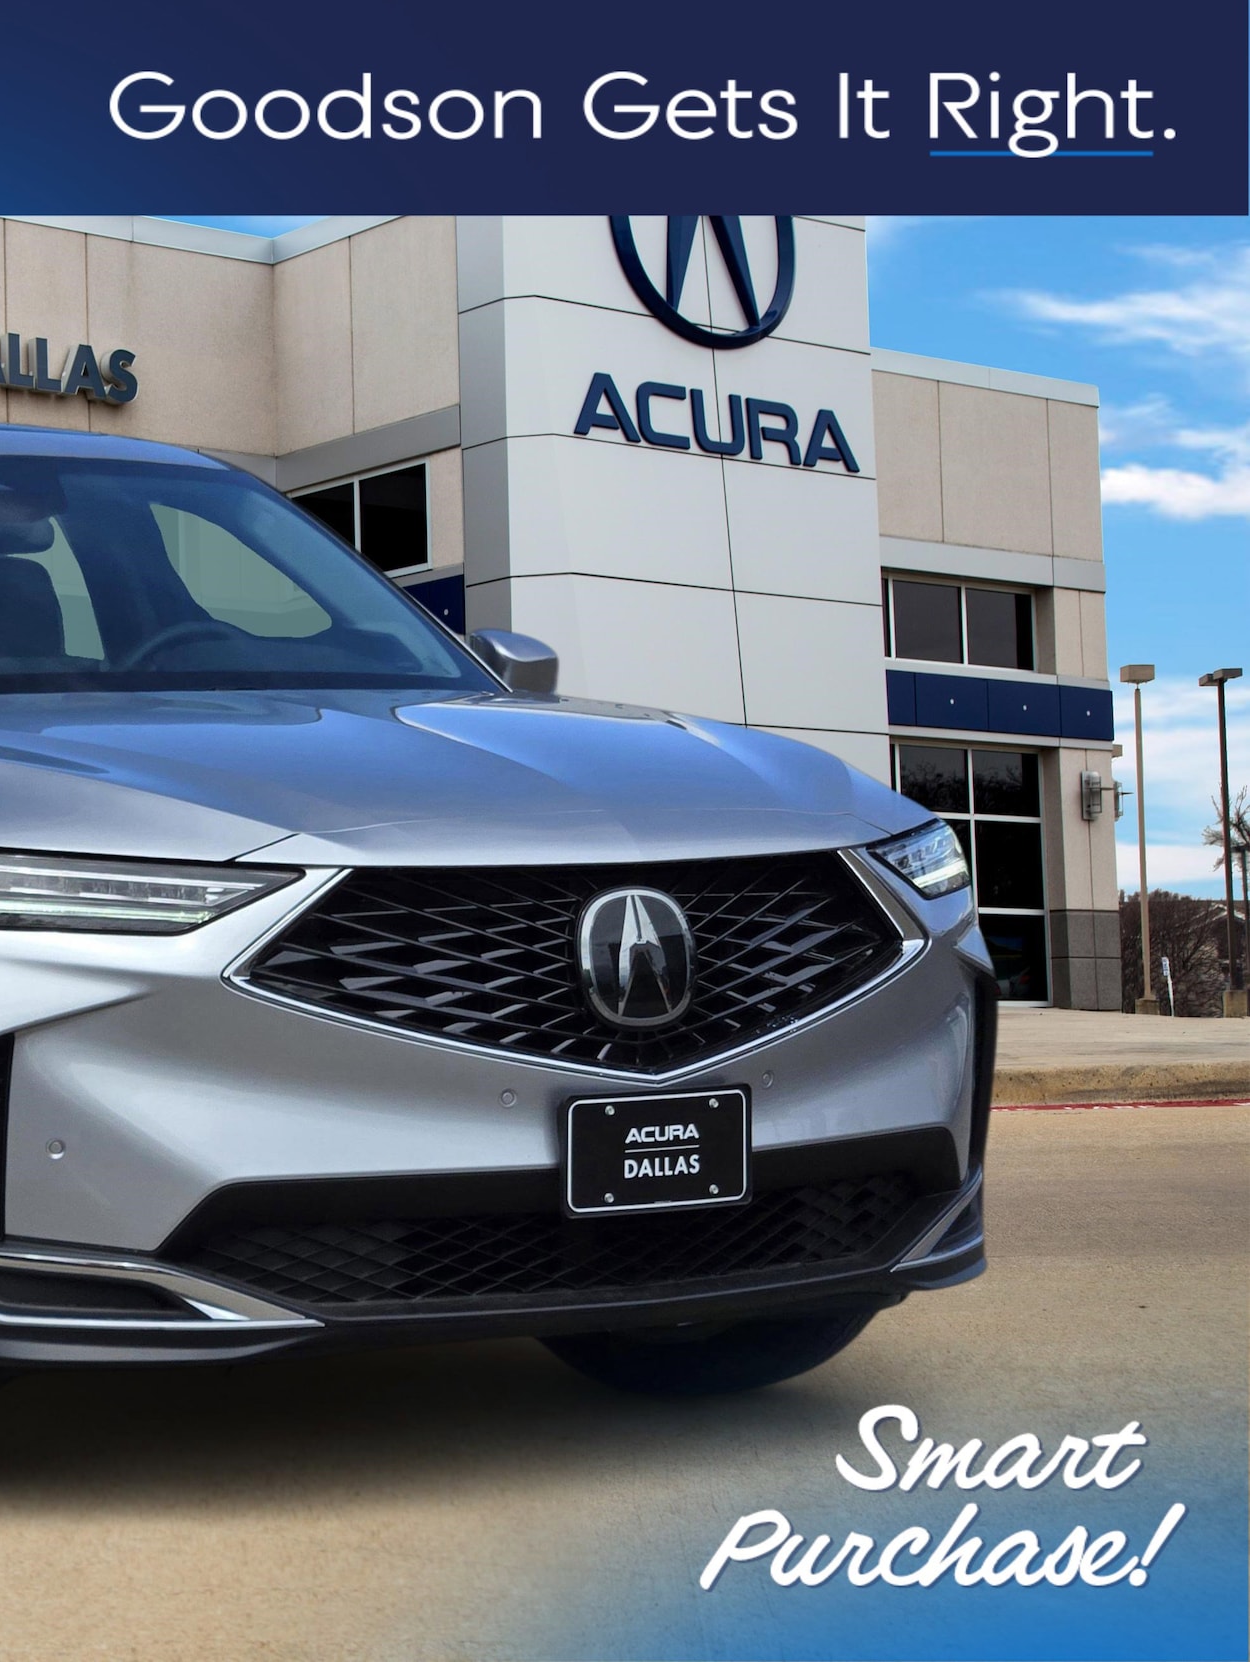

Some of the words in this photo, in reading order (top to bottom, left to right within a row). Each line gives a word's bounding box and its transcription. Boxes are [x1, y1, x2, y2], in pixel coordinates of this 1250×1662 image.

[573, 372, 862, 475] ACURA
[624, 1123, 700, 1145] ACURA
[623, 1154, 700, 1180] DALLAS
